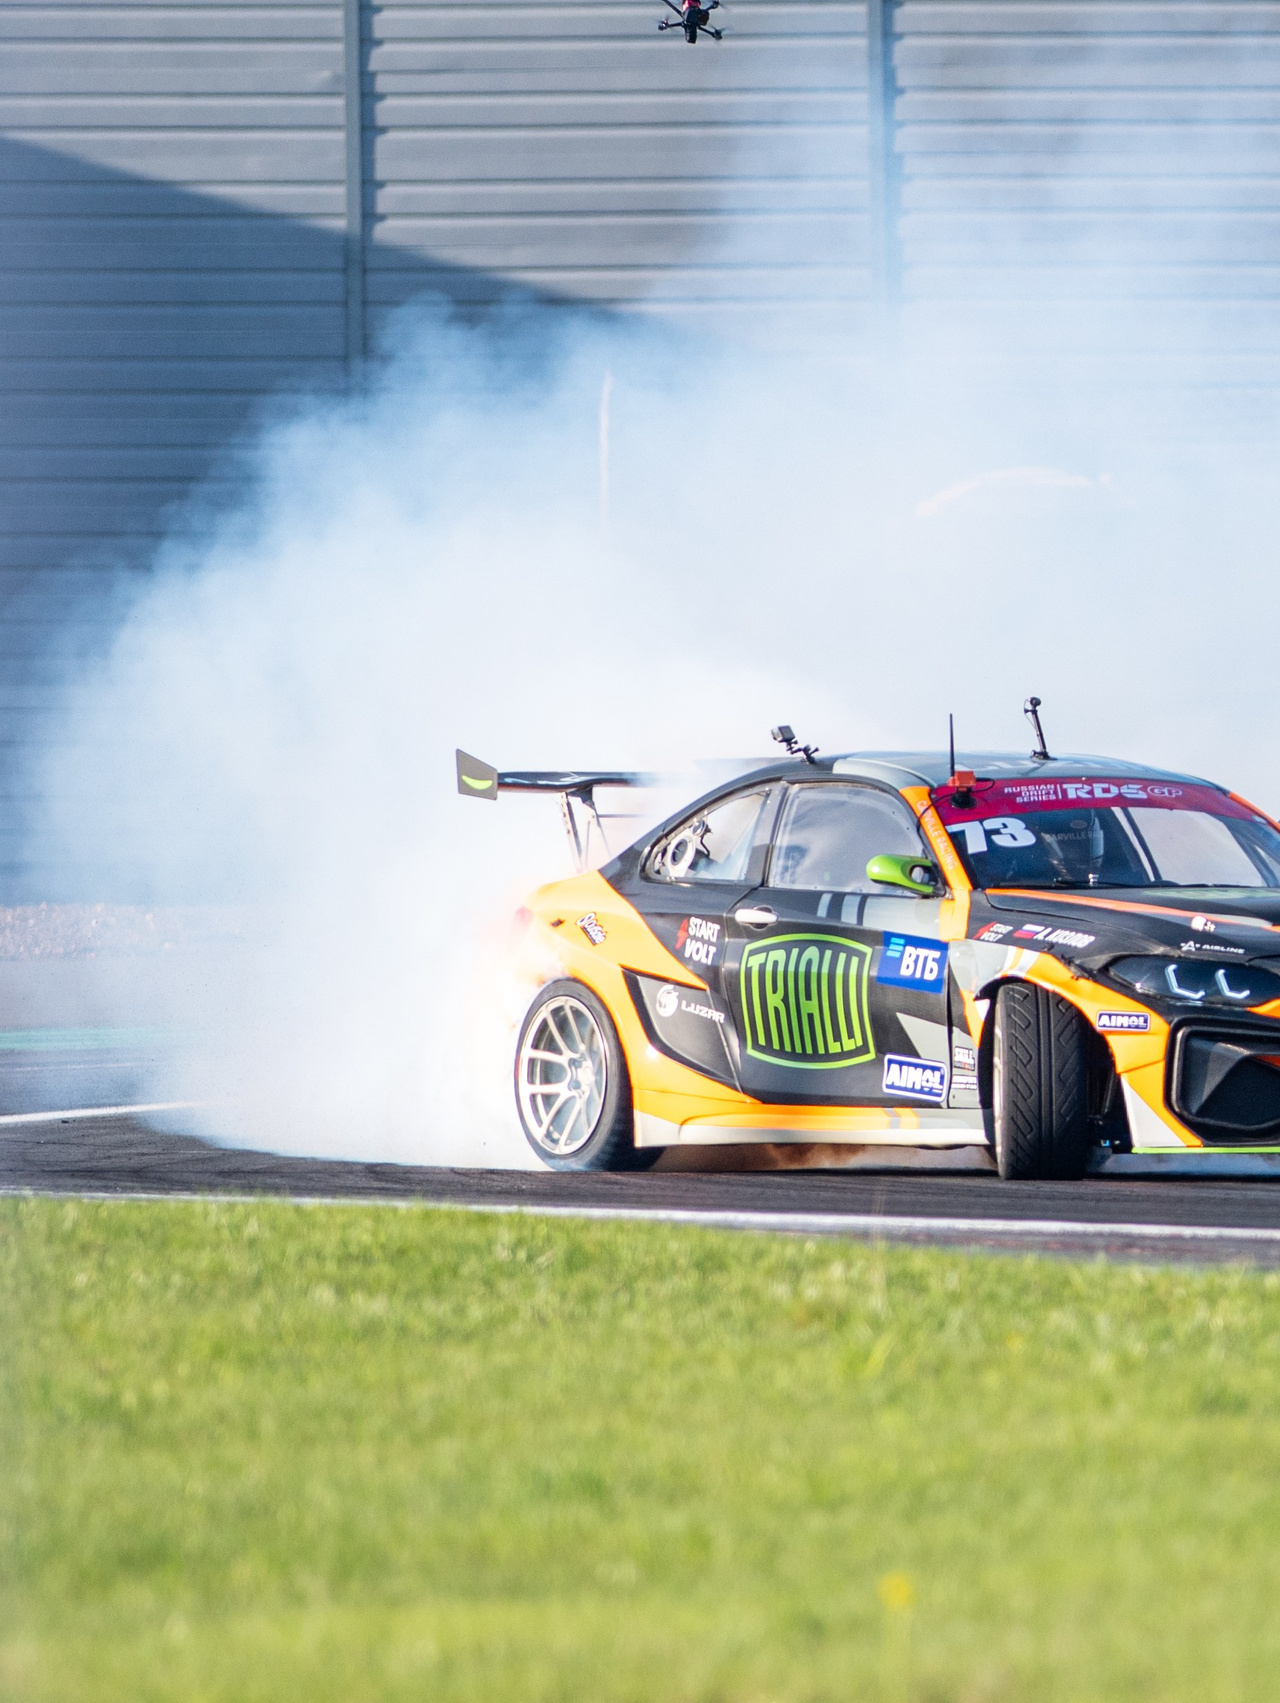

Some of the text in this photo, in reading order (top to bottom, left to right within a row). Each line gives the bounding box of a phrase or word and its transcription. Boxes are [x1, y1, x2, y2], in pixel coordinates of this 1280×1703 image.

[1004, 783, 1055, 794] RUSSIAN
[1016, 794, 1056, 803] SERIES
[1021, 789, 1055, 797] DRIFT
[1062, 783, 1148, 799] RDS
[945, 817, 1037, 855] 73
[935, 836, 958, 870] RACING
[688, 916, 721, 943] START
[684, 938, 717, 965] VOLT
[1201, 943, 1246, 954] AIRLINE
[900, 945, 941, 981] ВТБ
[680, 999, 726, 1024] LUZAR
[747, 945, 864, 1054] TRIALLI
[1098, 1014, 1147, 1028] AIMOL
[885, 1062, 945, 1093] AIMOL
